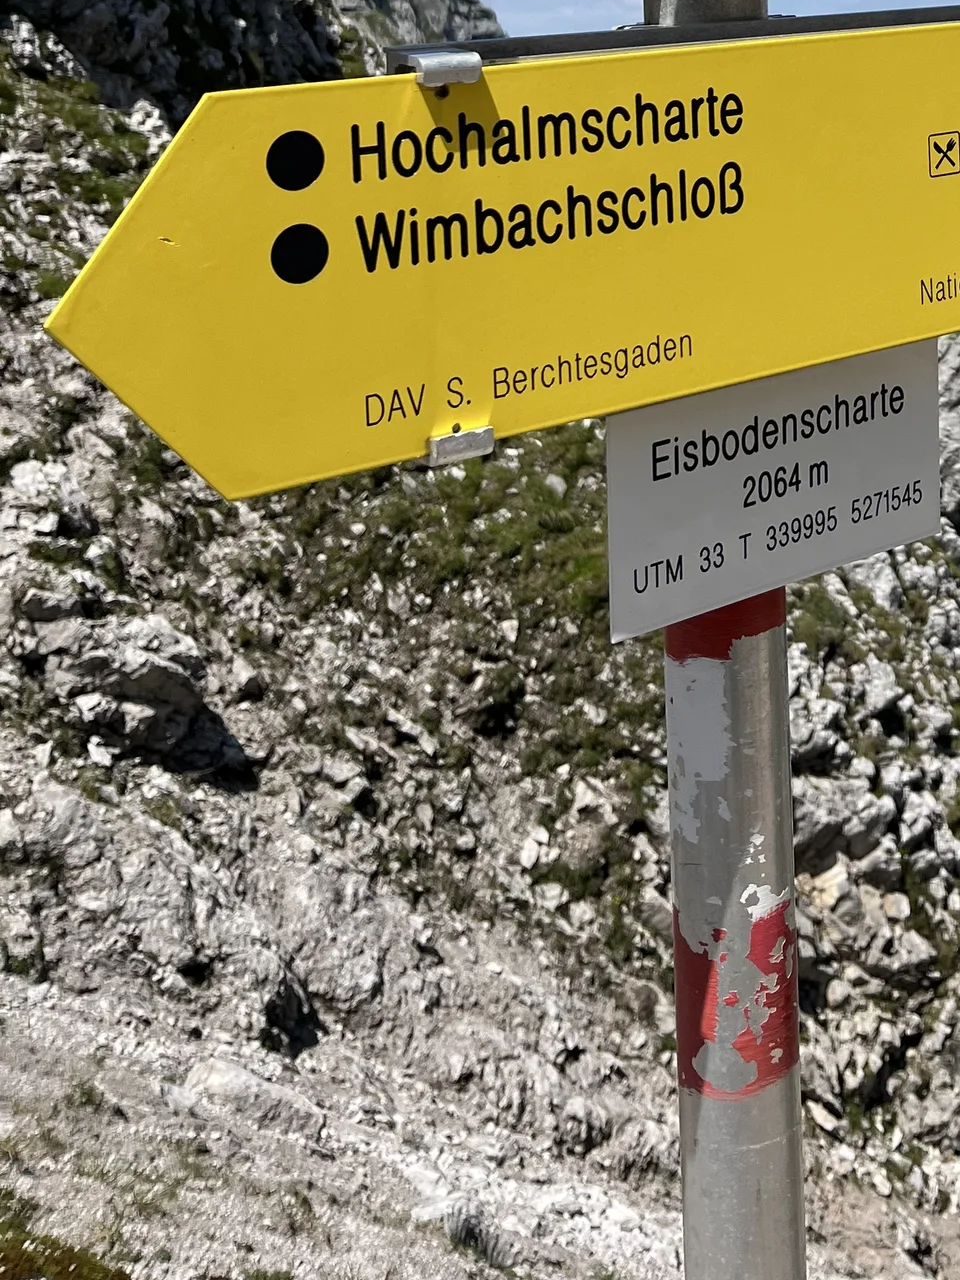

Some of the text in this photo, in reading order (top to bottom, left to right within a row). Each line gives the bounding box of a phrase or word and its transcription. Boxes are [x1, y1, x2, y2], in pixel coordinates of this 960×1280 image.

[351, 87, 744, 184] Hochalmscharte
[356, 161, 745, 272] Wimbachschloß
[365, 332, 693, 427] DAV S. Berchtesgaden
[652, 383, 904, 482] Eisbodenscharte
[743, 460, 829, 508] 2064 m
[634, 480, 923, 593] UTM 33 T 339995 5271545
